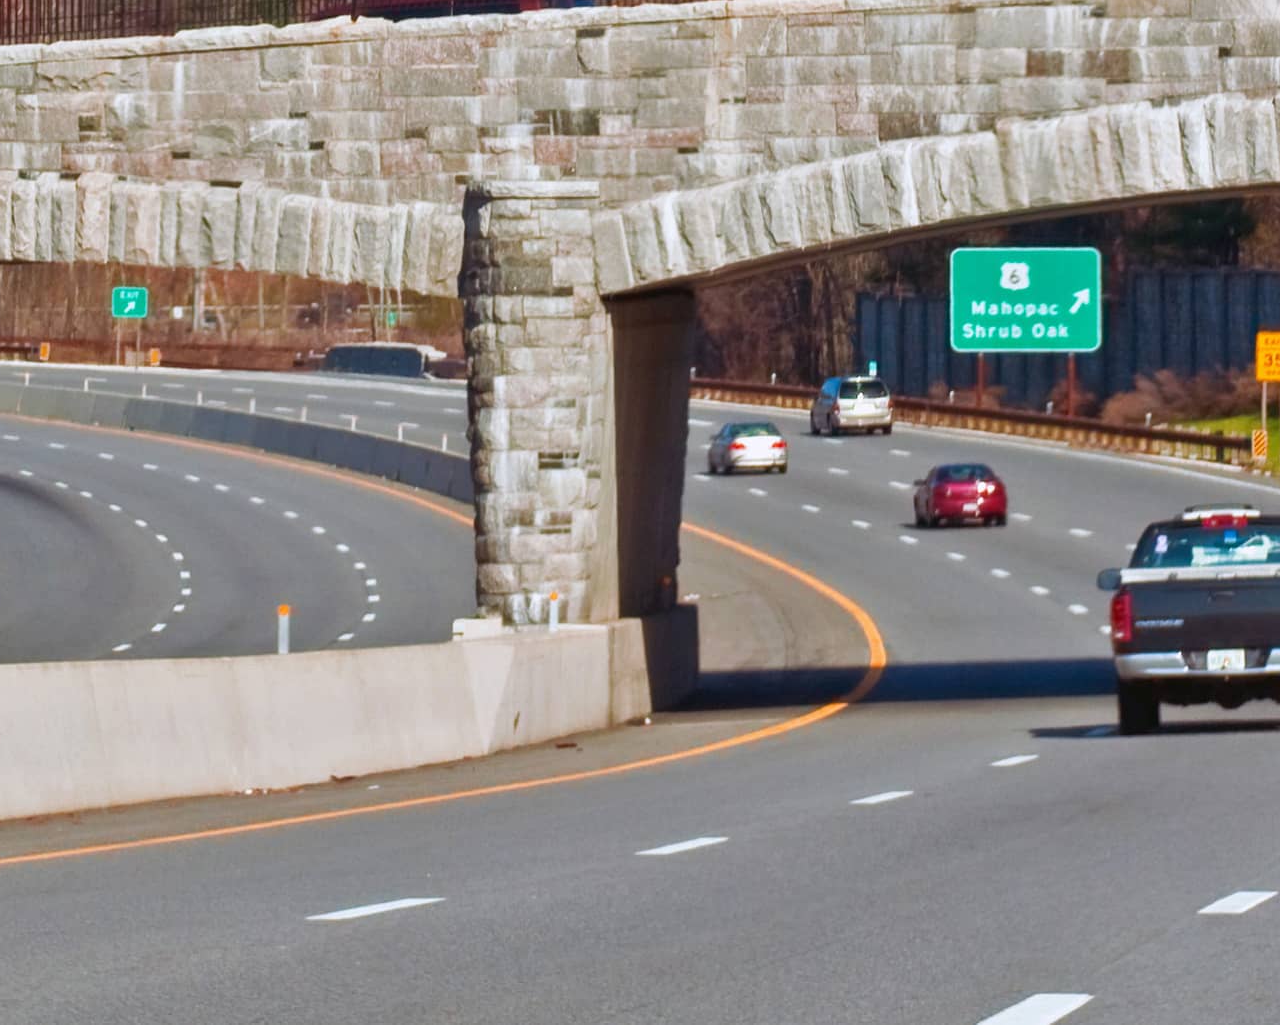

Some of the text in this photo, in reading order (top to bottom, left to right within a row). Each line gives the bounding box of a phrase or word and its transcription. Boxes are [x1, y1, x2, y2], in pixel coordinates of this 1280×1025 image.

[1009, 269, 1021, 285] 6
[971, 300, 1059, 318] Mahopac
[962, 323, 1069, 339] Shrub Oak
